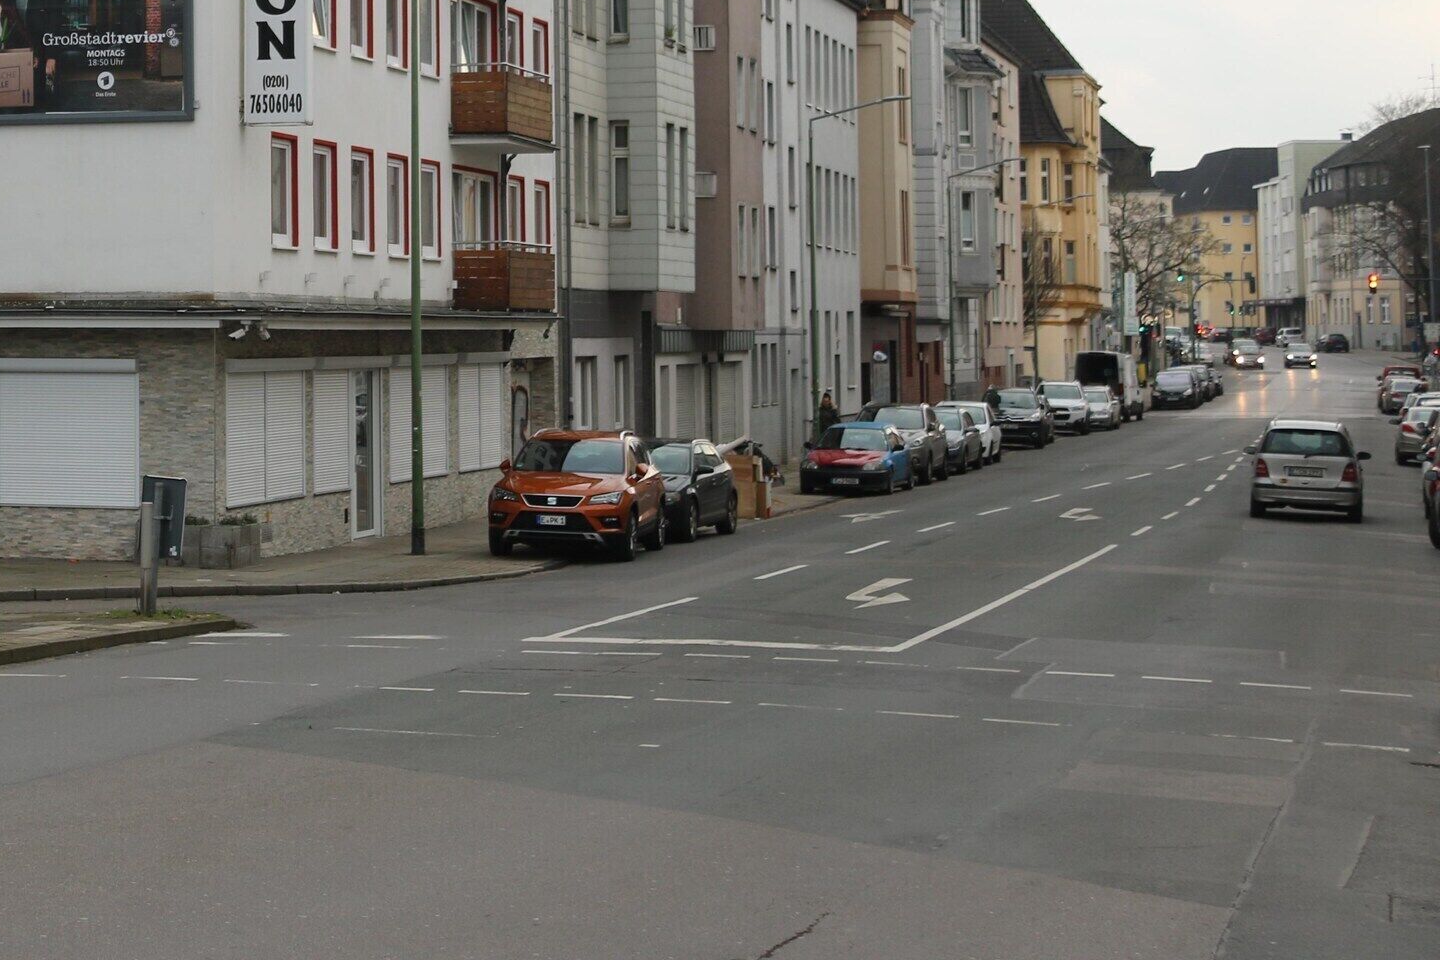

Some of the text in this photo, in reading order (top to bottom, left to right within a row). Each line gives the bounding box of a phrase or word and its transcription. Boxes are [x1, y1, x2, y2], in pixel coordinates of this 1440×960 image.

[42, 30, 166, 46] Großstadtrevier
[86, 49, 125, 57] MONTAGS
[110, 58, 124, 66] Uhr
[262, 74, 289, 91] (0201)
[250, 93, 302, 114] 76506040
